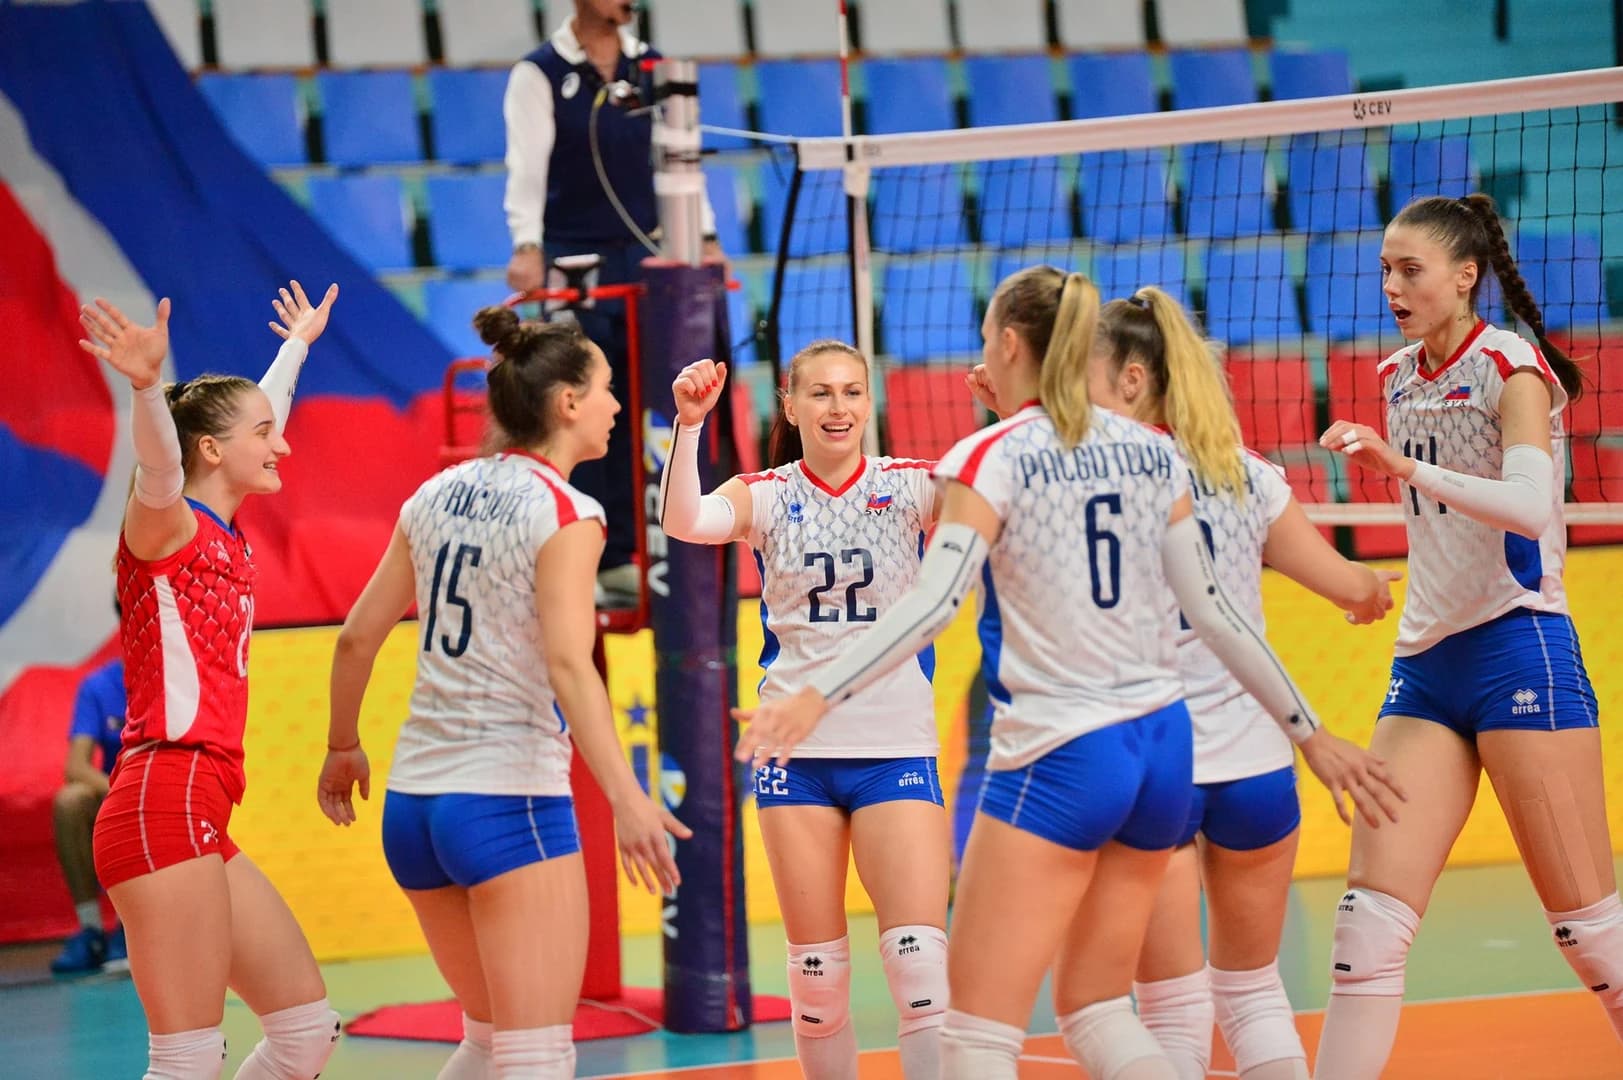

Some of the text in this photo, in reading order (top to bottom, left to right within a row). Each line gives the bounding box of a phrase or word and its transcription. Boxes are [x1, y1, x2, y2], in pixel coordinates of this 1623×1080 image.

[1368, 99, 1392, 116] CEV
[1085, 493, 1122, 609] 6
[424, 540, 482, 658] 15
[804, 548, 877, 622] 22
[802, 968, 823, 976] errea
[899, 945, 920, 955] errea
